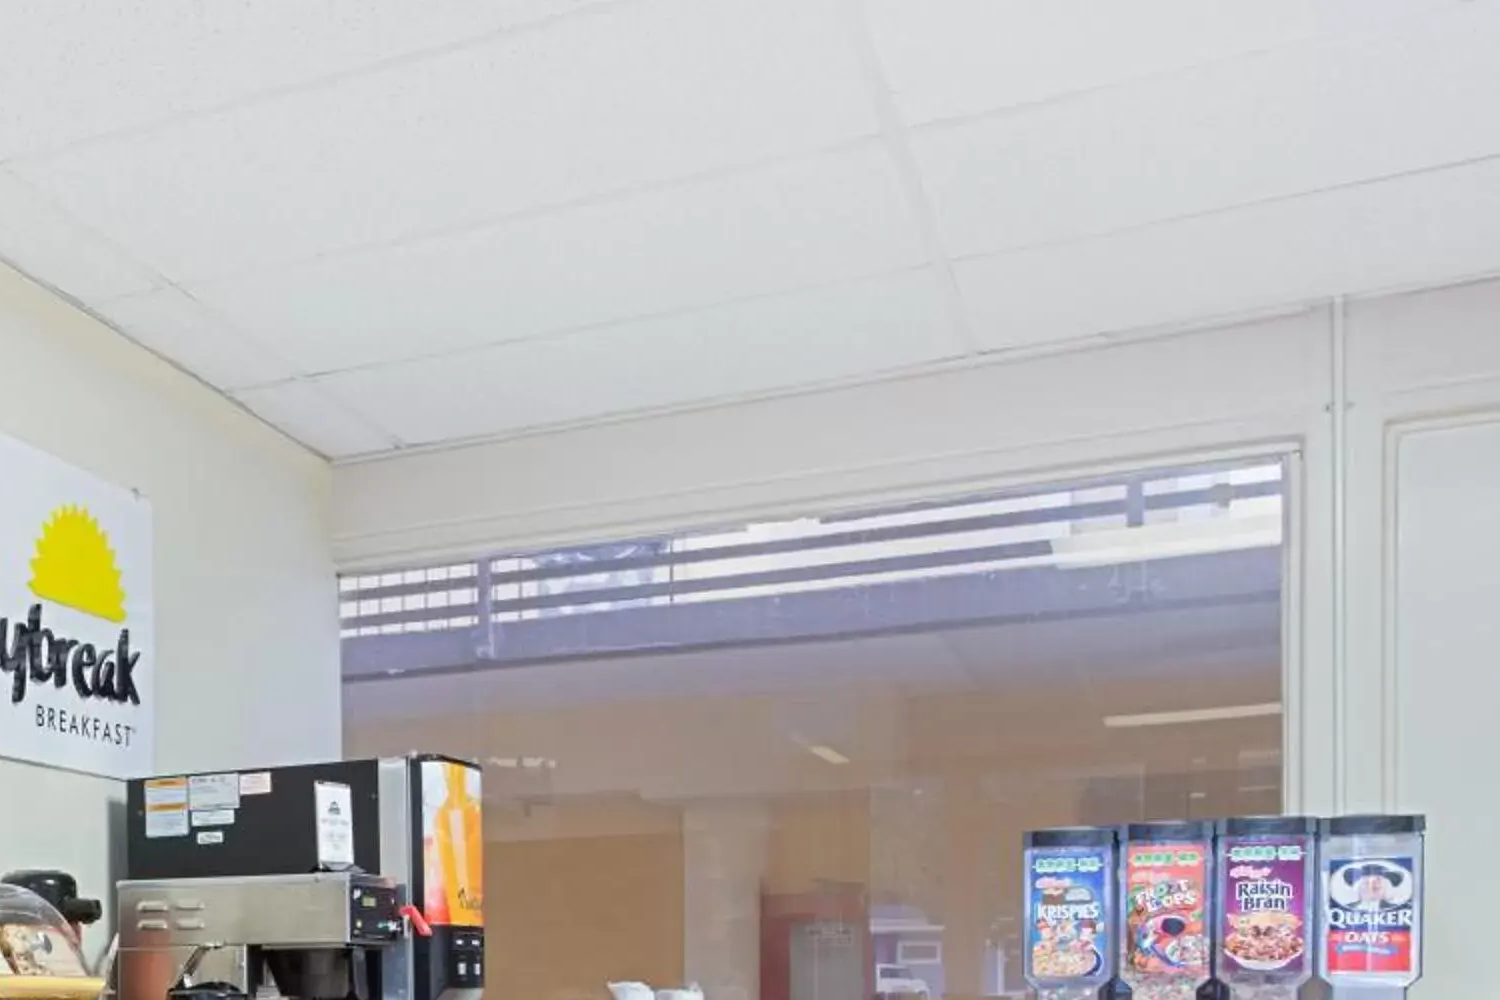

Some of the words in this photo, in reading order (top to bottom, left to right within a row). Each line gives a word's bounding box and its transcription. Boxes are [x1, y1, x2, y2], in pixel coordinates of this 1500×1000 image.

[35, 703, 132, 748] BREAKFAST
[1236, 880, 1293, 899] Raisin
[1036, 902, 1100, 924] KRISPIES
[1242, 896, 1286, 912] Bran
[1329, 908, 1413, 929] QUAKER
[1344, 931, 1392, 944] OATS
